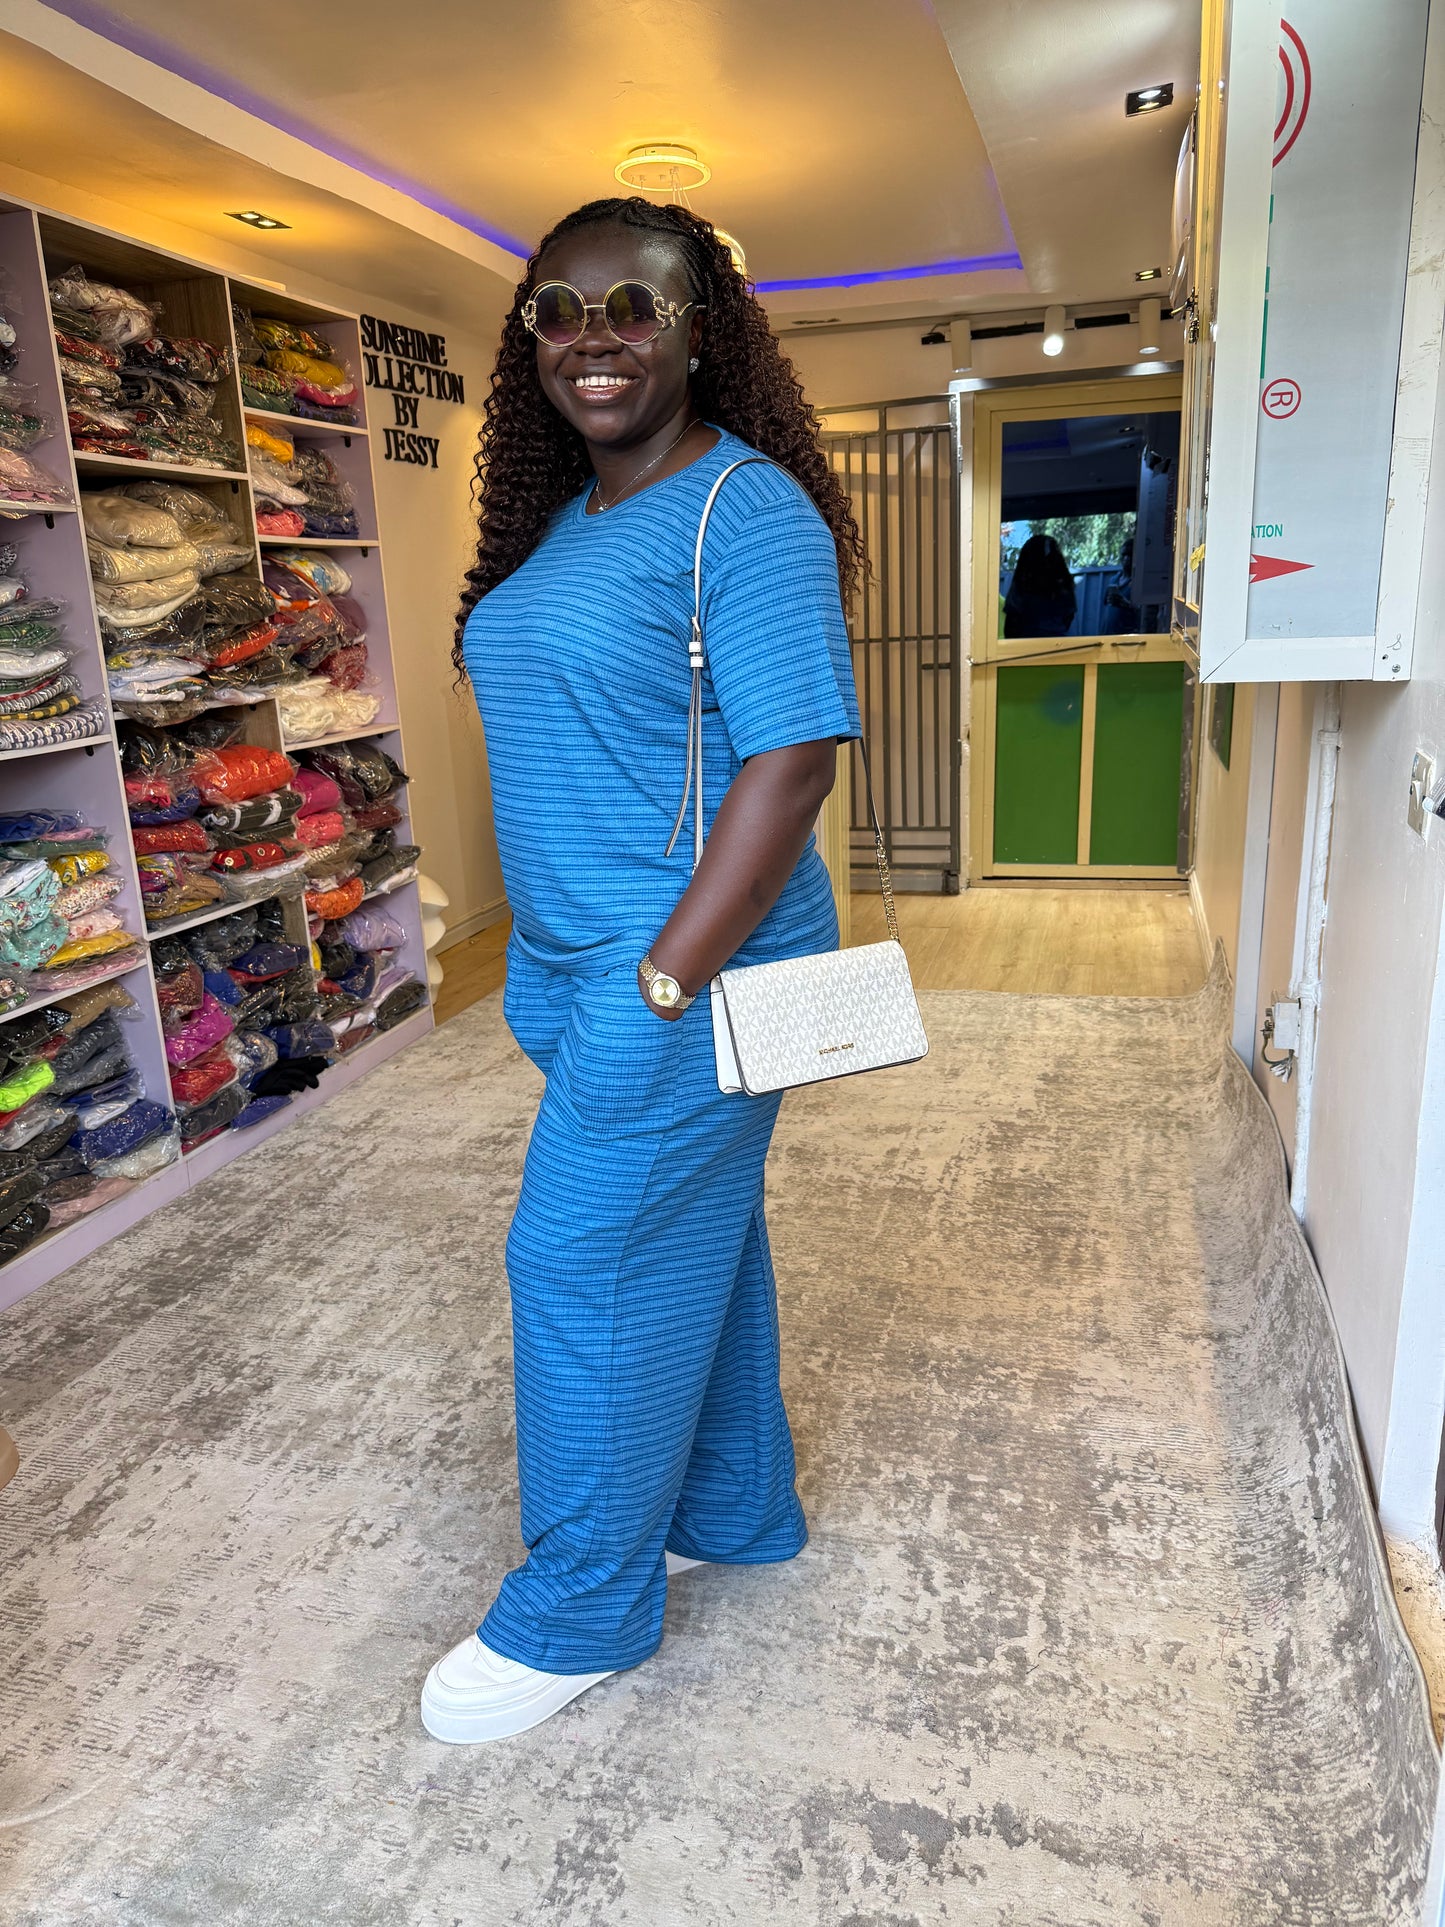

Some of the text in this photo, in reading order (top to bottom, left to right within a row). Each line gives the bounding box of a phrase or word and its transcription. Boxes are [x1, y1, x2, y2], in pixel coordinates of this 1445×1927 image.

[360, 314, 447, 367] SUNSHINE
[392, 393, 419, 428] BY
[383, 428, 440, 468] JESSY
